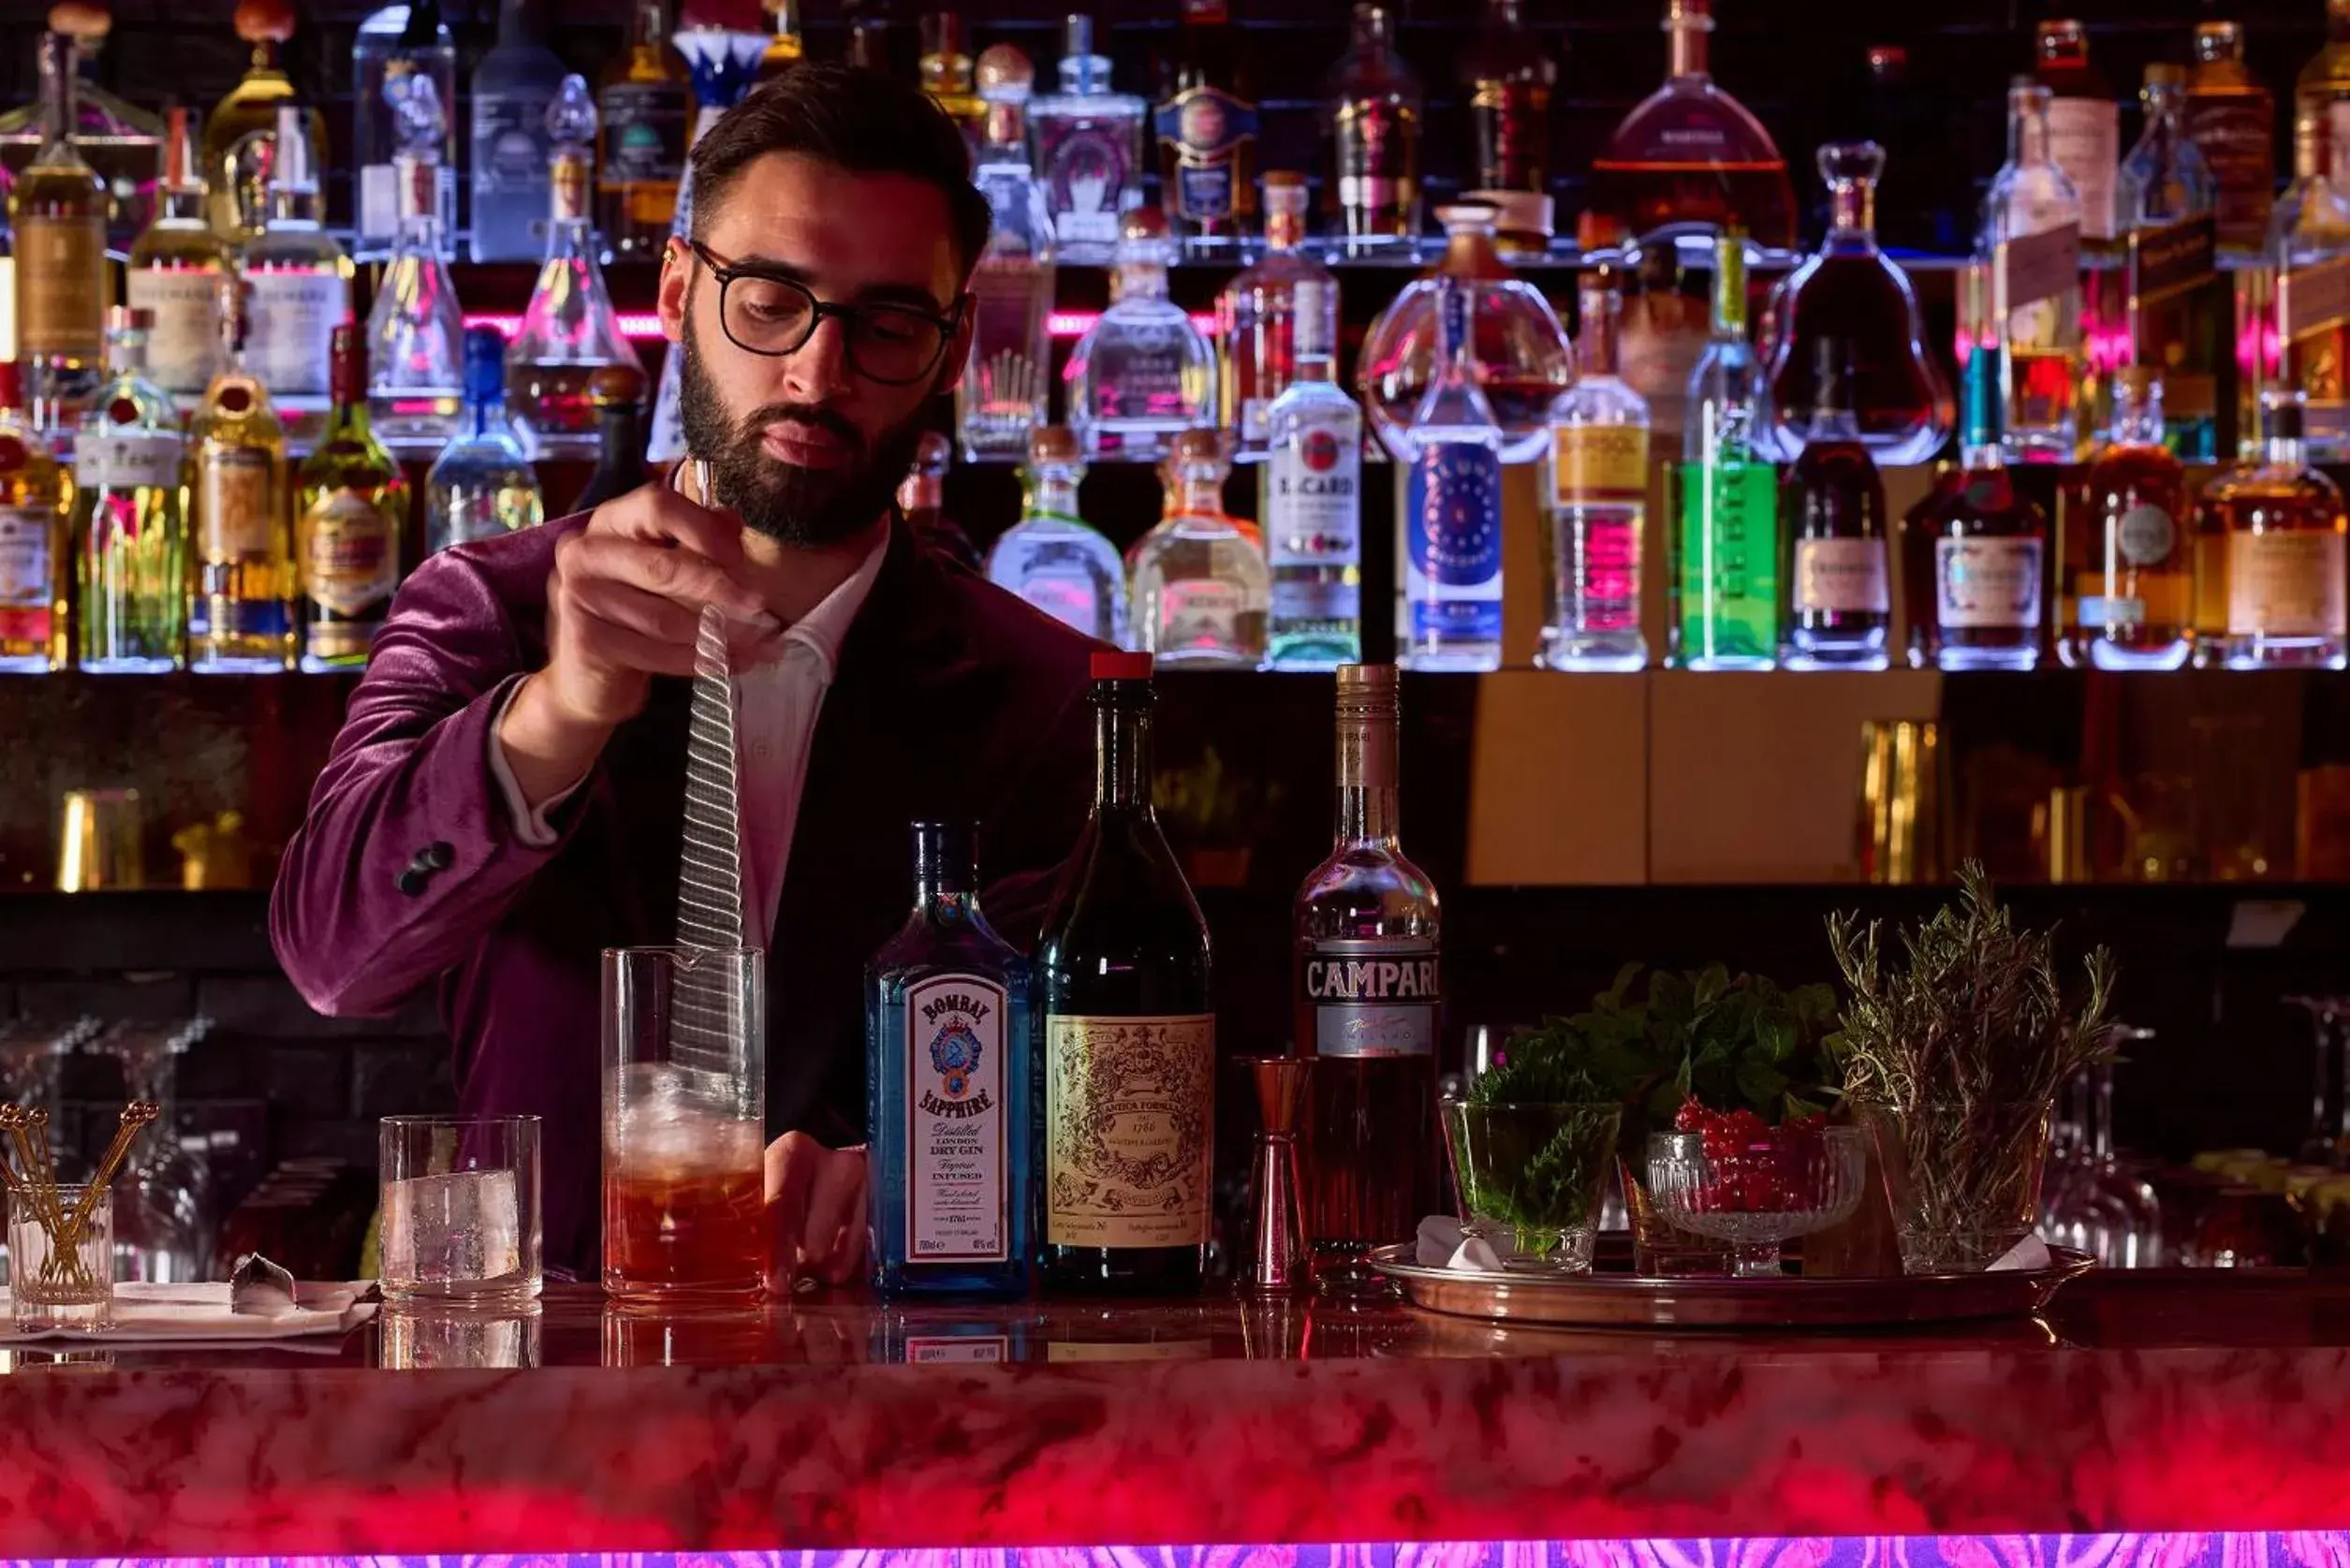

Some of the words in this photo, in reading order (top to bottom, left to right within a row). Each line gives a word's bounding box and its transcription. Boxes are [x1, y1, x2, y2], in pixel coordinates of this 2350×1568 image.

[1307, 960, 1440, 998] CAMPARI
[921, 994, 991, 1025] BOMBAY
[918, 1088, 994, 1119] SAPPHIRE
[933, 1122, 982, 1137] Distilled
[930, 1146, 957, 1155] DRY
[959, 1146, 983, 1155] GIN
